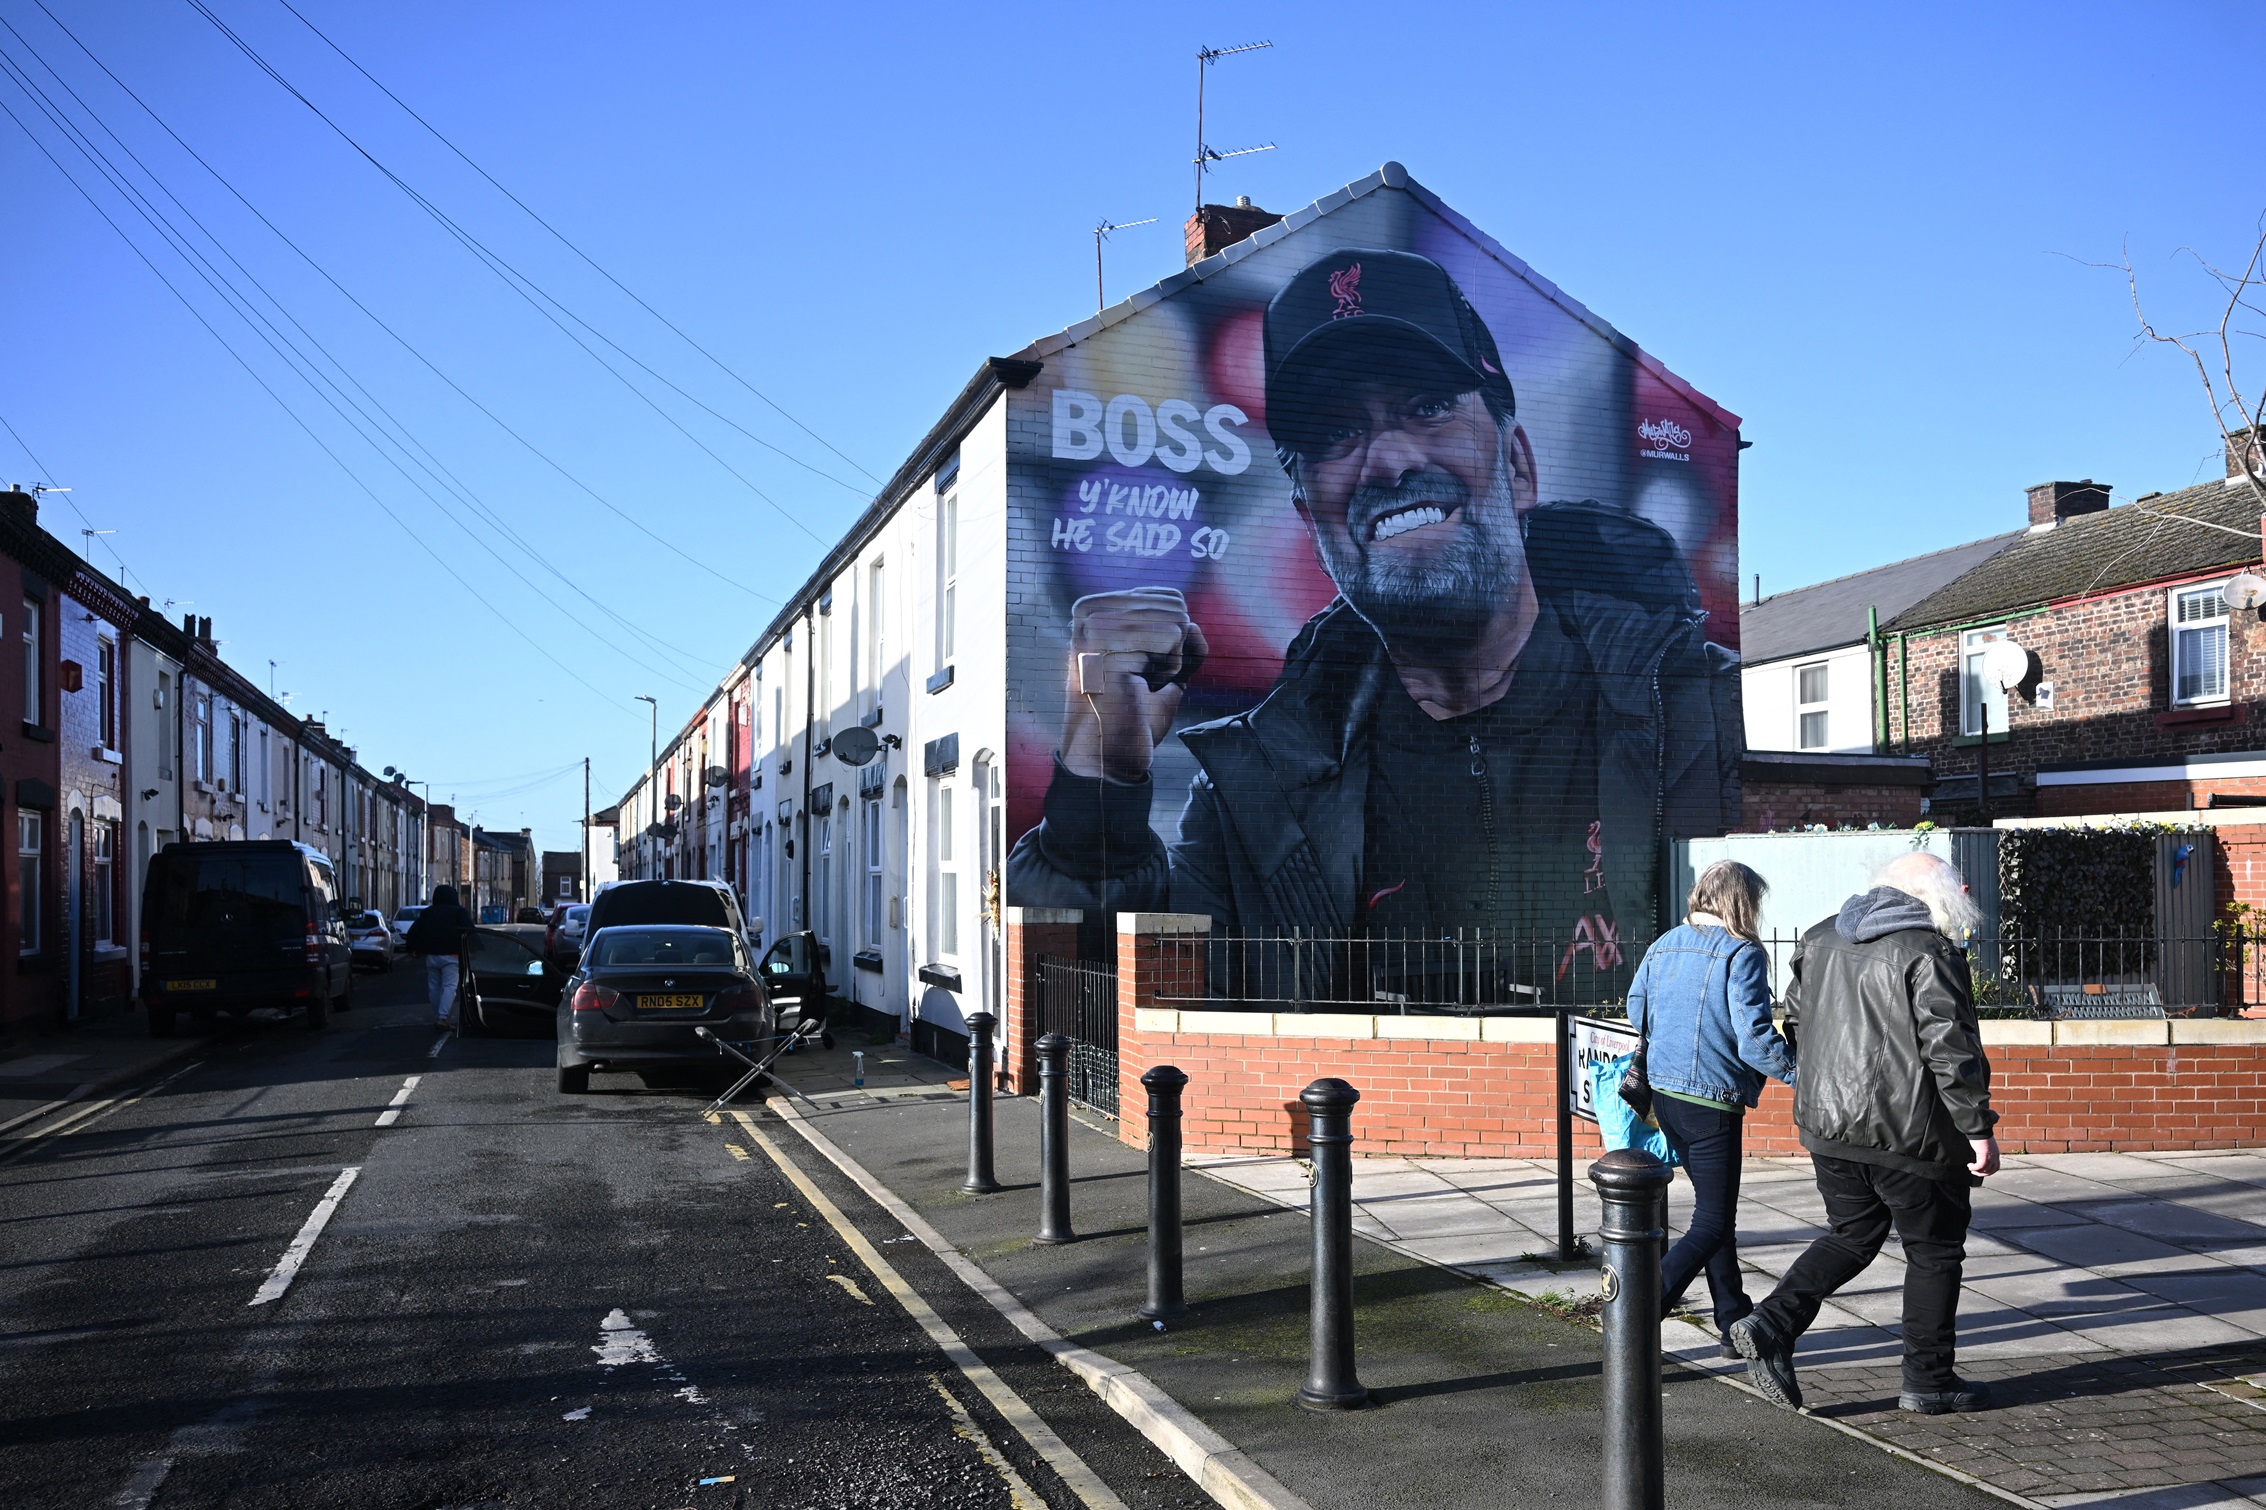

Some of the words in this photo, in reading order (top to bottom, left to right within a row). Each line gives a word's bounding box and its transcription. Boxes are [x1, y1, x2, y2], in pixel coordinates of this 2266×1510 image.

[1052, 389, 1251, 475] BOSS
[1640, 449, 1690, 461] @MURWALLS
[1079, 478, 1199, 520] Y'KNOW
[1051, 518, 1096, 551] HE
[1105, 521, 1182, 556] SAID
[1190, 526, 1230, 560] SO
[641, 995, 673, 1007] RN05
[676, 994, 699, 1006] SZX
[1590, 1031, 1600, 1047] City
[1600, 1034, 1607, 1049] of
[1606, 1035, 1631, 1053] Liverpool
